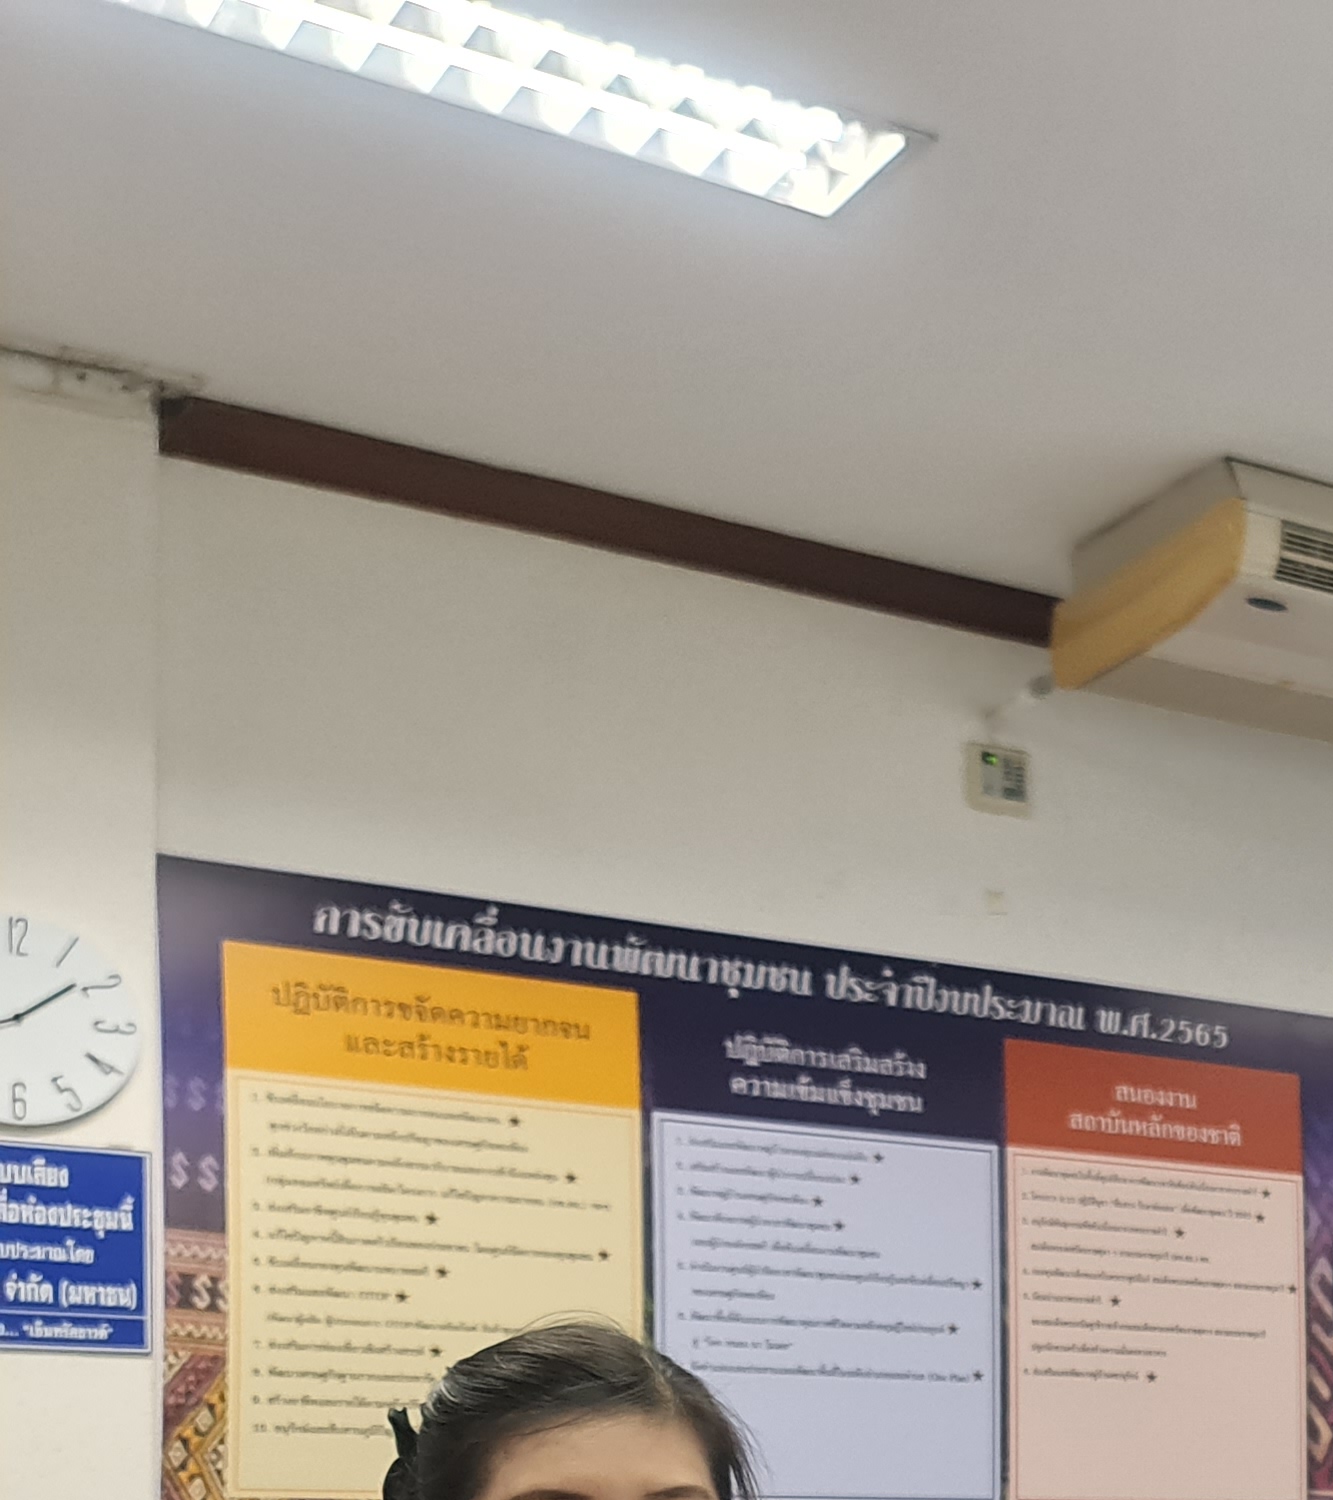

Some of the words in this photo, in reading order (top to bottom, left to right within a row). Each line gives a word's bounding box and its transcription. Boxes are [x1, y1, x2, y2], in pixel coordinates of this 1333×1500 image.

[8, 916, 28, 956] 12
[312, 899, 812, 999] การขับเคลื่อนงานพัฒนาชุมชน
[81, 974, 122, 998] 2
[94, 1020, 137, 1035] 3
[85, 1052, 124, 1076] 4
[345, 1030, 530, 1071] และสร้างรายได้
[12, 1082, 28, 1120] 6
[51, 1075, 82, 1113] 5
